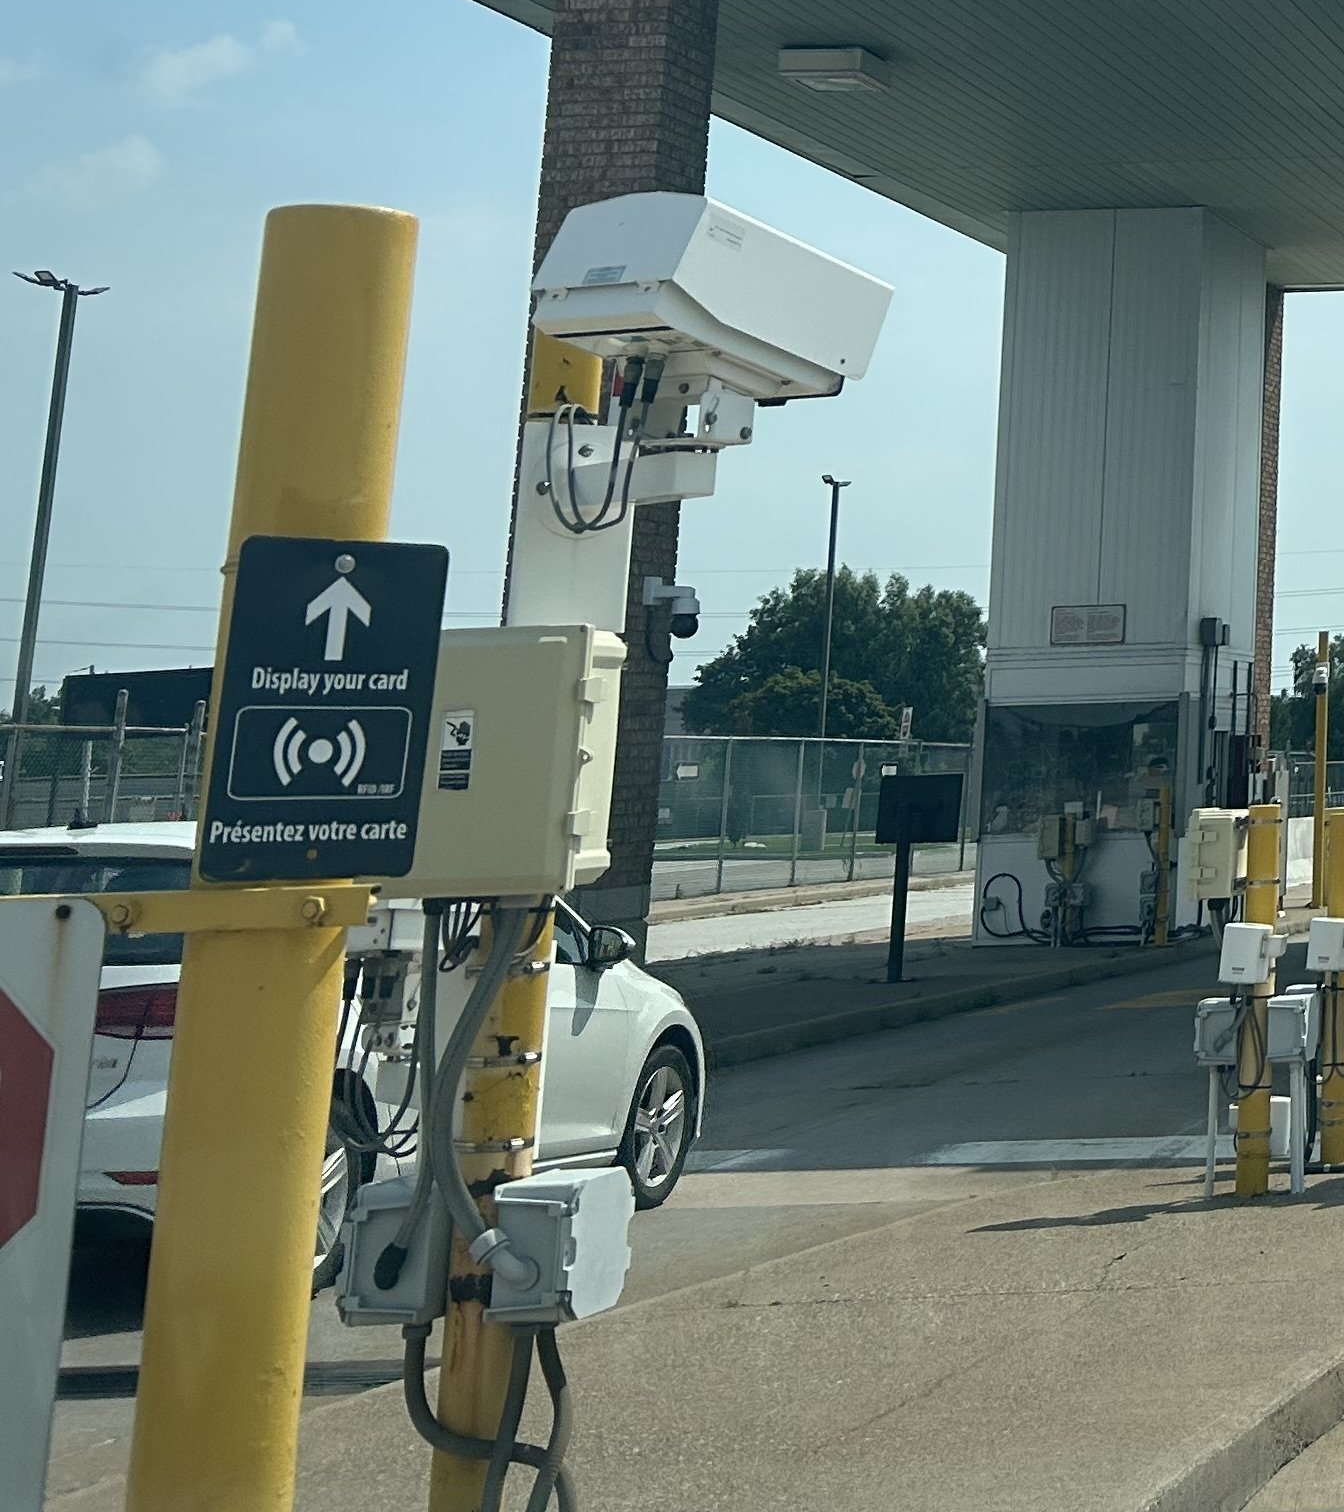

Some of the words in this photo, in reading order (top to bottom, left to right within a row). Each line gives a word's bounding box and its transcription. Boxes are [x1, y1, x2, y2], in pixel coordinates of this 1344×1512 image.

[251, 666, 320, 695] Display
[322, 673, 366, 695] your
[368, 668, 409, 690] card
[208, 819, 305, 844] Présentez
[308, 820, 358, 841] votre
[359, 820, 408, 840] carte
